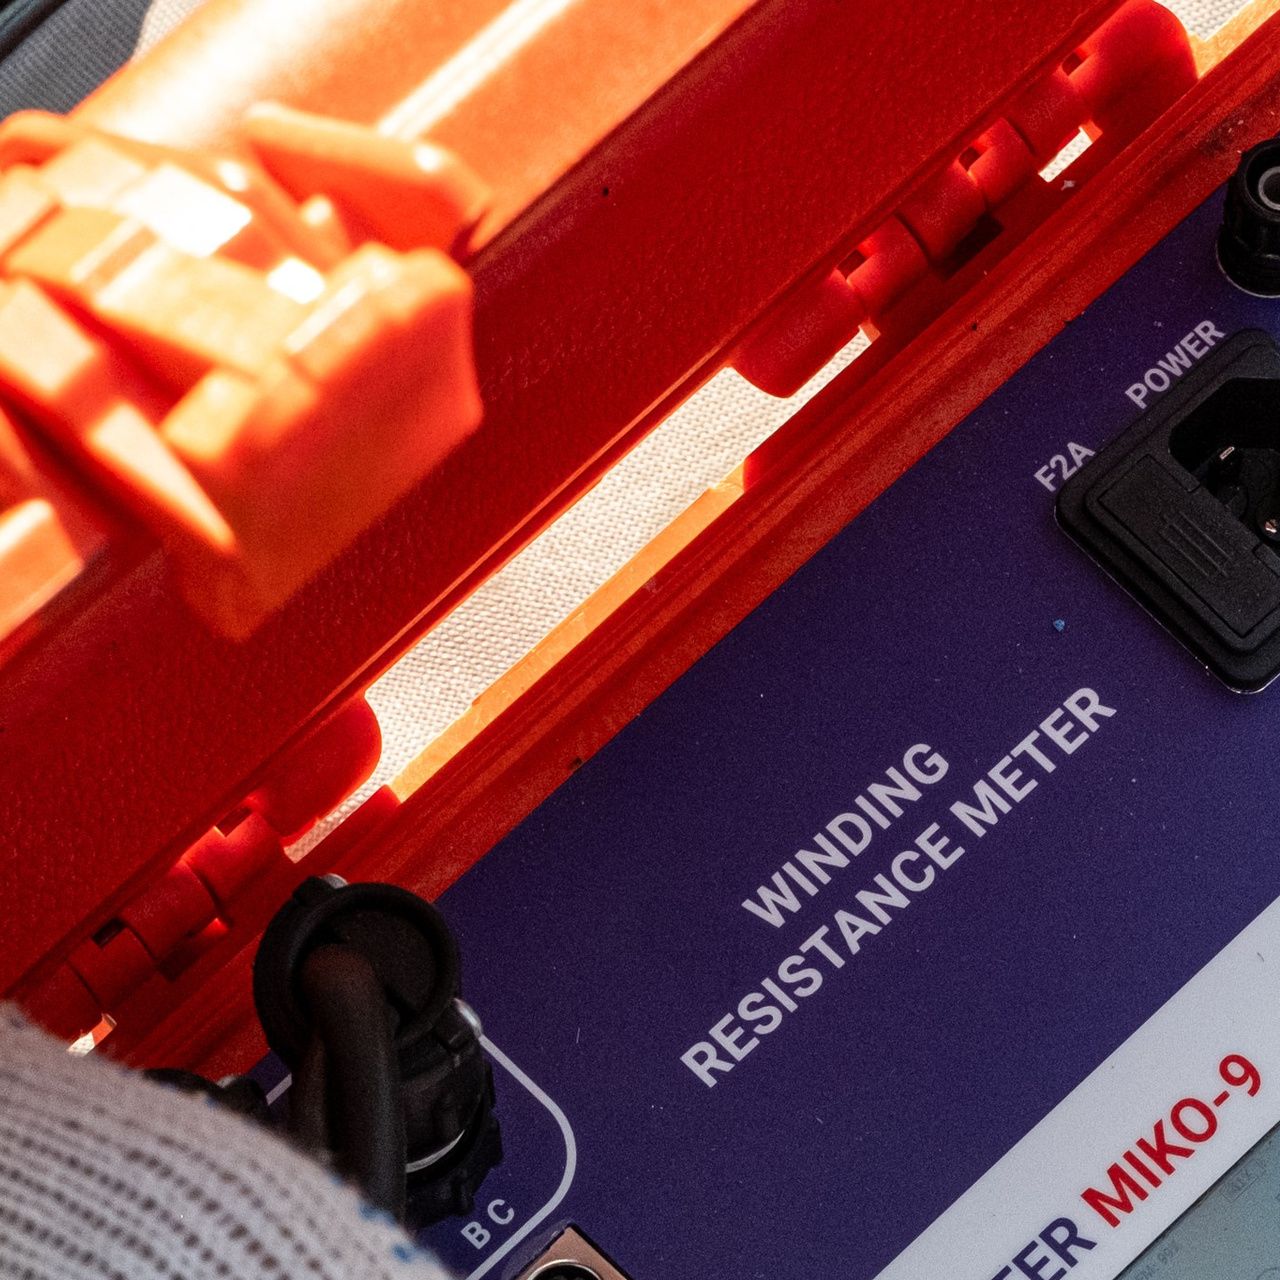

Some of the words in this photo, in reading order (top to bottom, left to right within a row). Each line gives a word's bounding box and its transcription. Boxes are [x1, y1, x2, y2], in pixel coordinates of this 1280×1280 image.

[1124, 320, 1225, 409] POWER
[1033, 441, 1095, 492] F2A
[680, 822, 966, 1088] RESISTANCE
[949, 687, 1117, 838] METER
[741, 743, 950, 928] WINDING
[1080, 1054, 1261, 1228] MIKO-9
